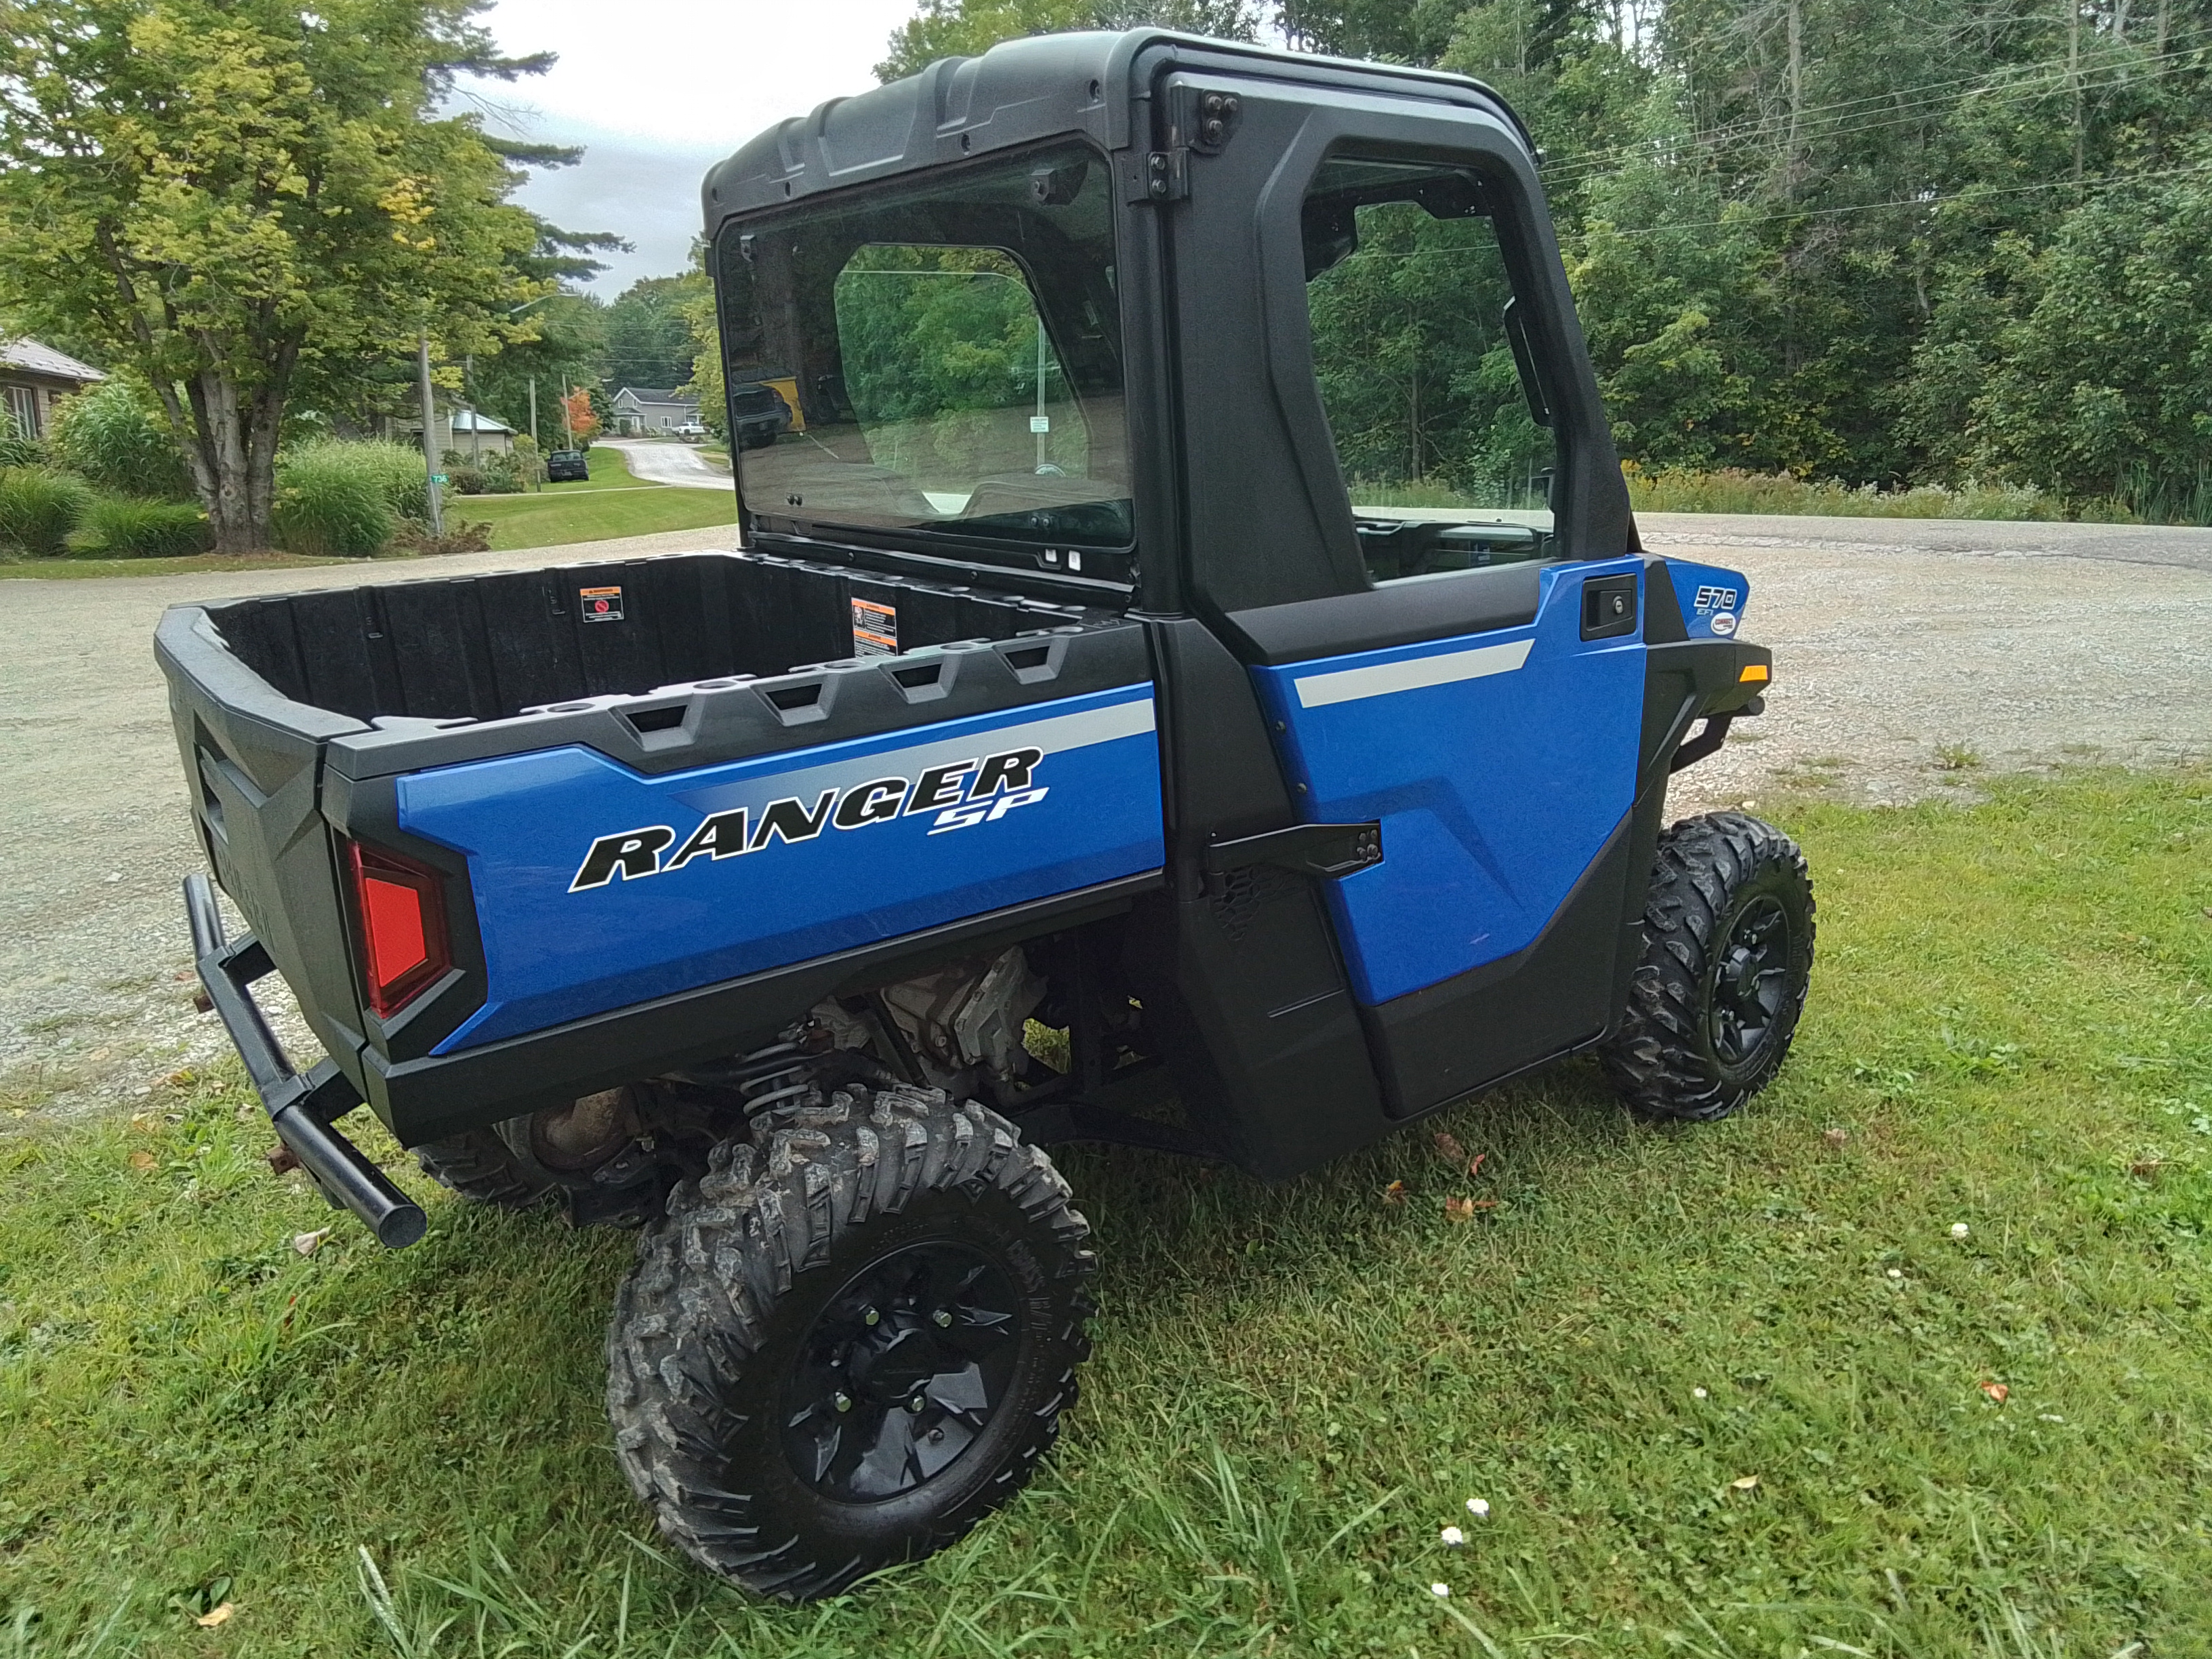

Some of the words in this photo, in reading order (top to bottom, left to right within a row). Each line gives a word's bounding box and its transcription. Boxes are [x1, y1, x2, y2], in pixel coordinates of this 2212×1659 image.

[1694, 585, 1737, 610] 570
[1696, 608, 1714, 616] EFI
[567, 746, 1044, 893] RANGER
[926, 787, 1050, 836] SP
